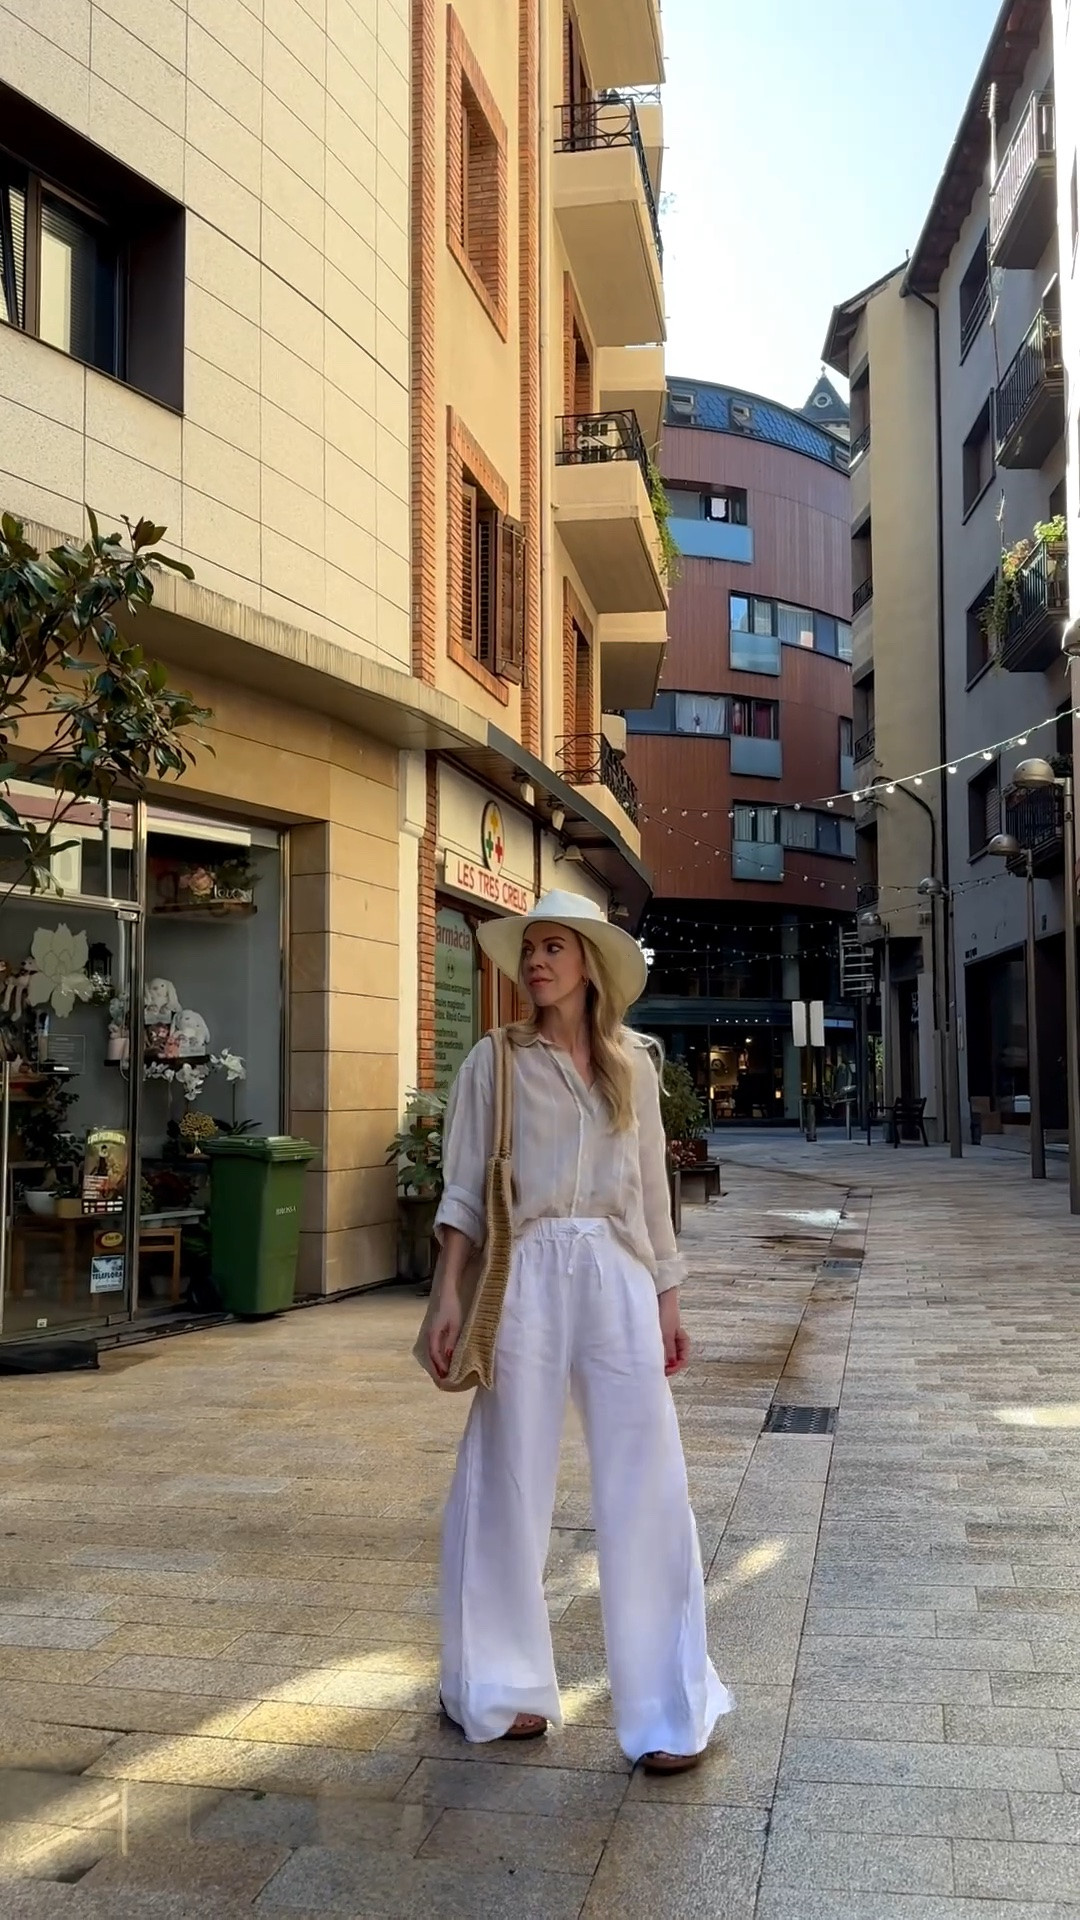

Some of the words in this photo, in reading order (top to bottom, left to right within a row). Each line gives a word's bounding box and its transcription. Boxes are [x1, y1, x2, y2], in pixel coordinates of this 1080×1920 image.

[457, 860, 475, 889] LES
[478, 870, 500, 901] TRES
[502, 882, 527, 912] CREUS
[436, 923, 470, 951] armàcia
[92, 1271, 122, 1280] TELEFLORA
